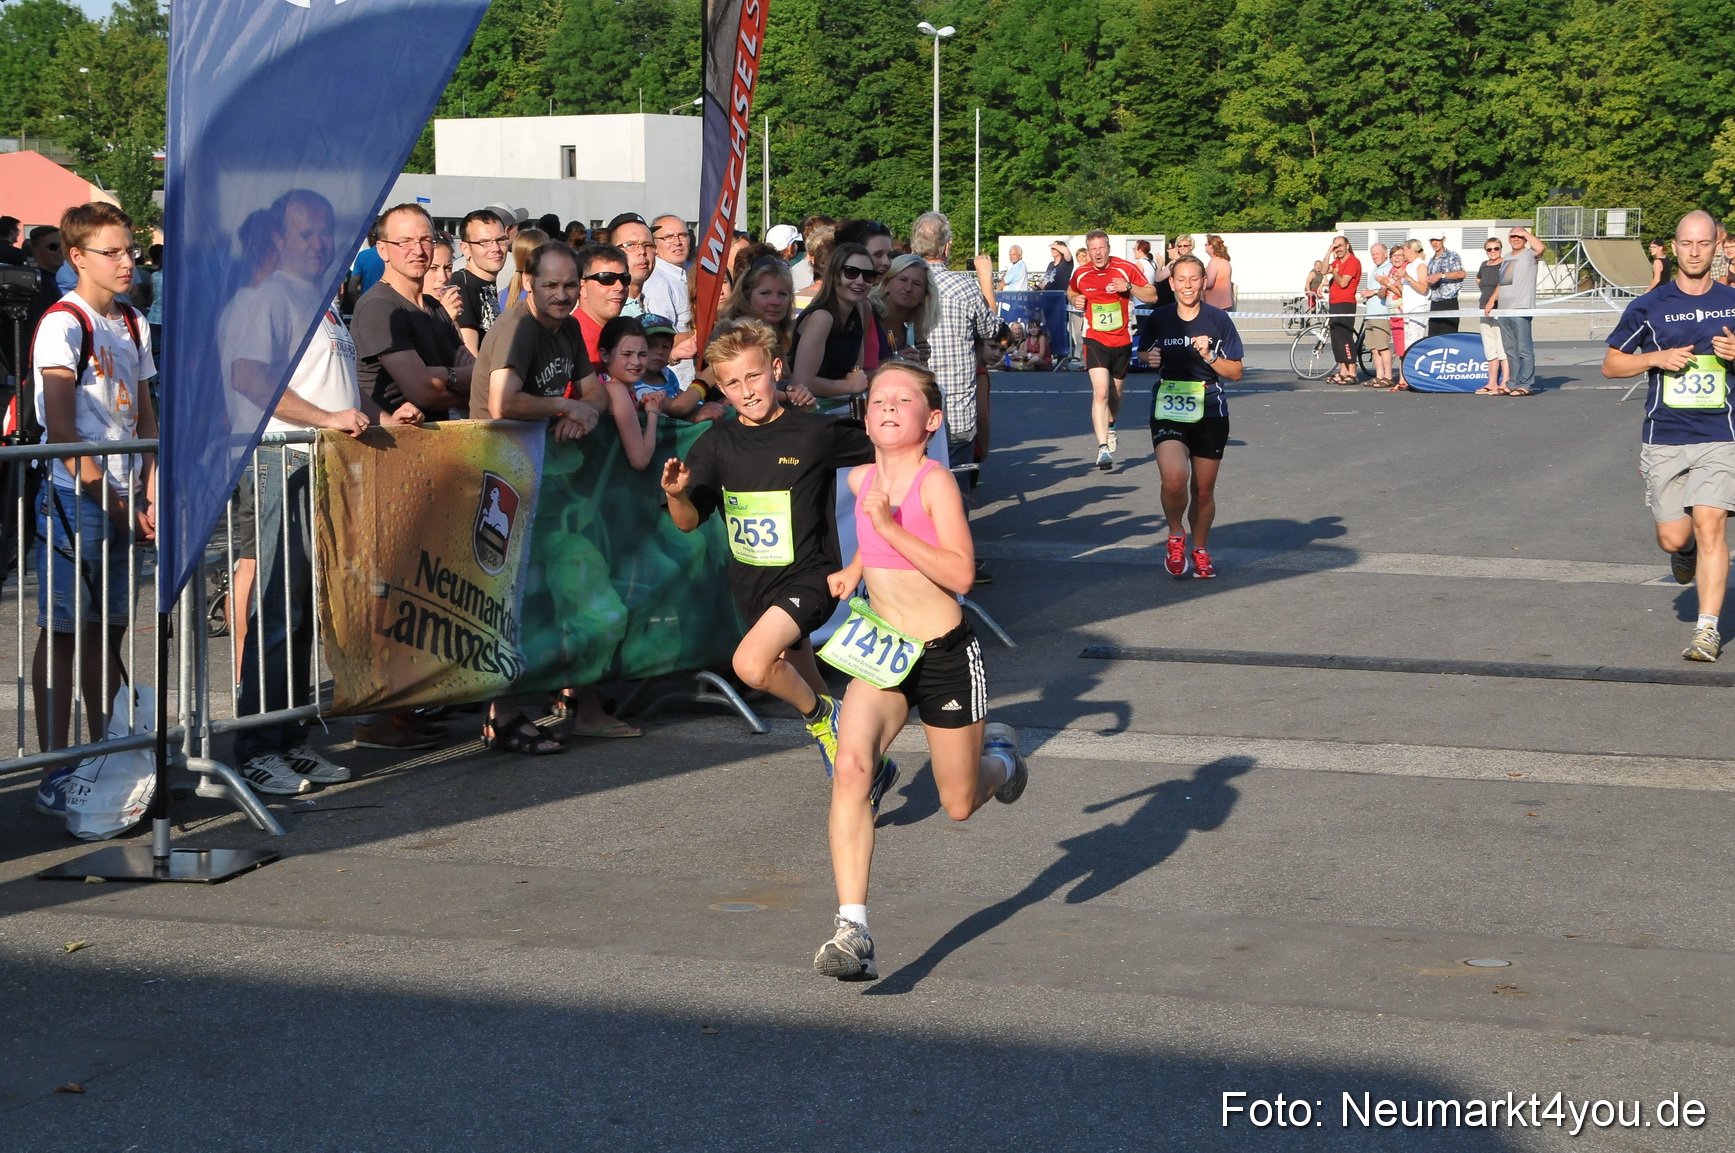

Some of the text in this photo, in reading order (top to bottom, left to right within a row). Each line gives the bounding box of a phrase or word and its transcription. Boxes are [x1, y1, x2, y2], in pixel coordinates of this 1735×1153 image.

[1099, 313, 1113, 325] 21
[1664, 312, 1695, 323] EURO
[1163, 338, 1184, 346] EURO
[1673, 373, 1716, 395] 333
[1163, 395, 1197, 412] 335
[778, 456, 800, 466] Philip
[729, 516, 779, 548] 253
[841, 616, 915, 674] 1416
